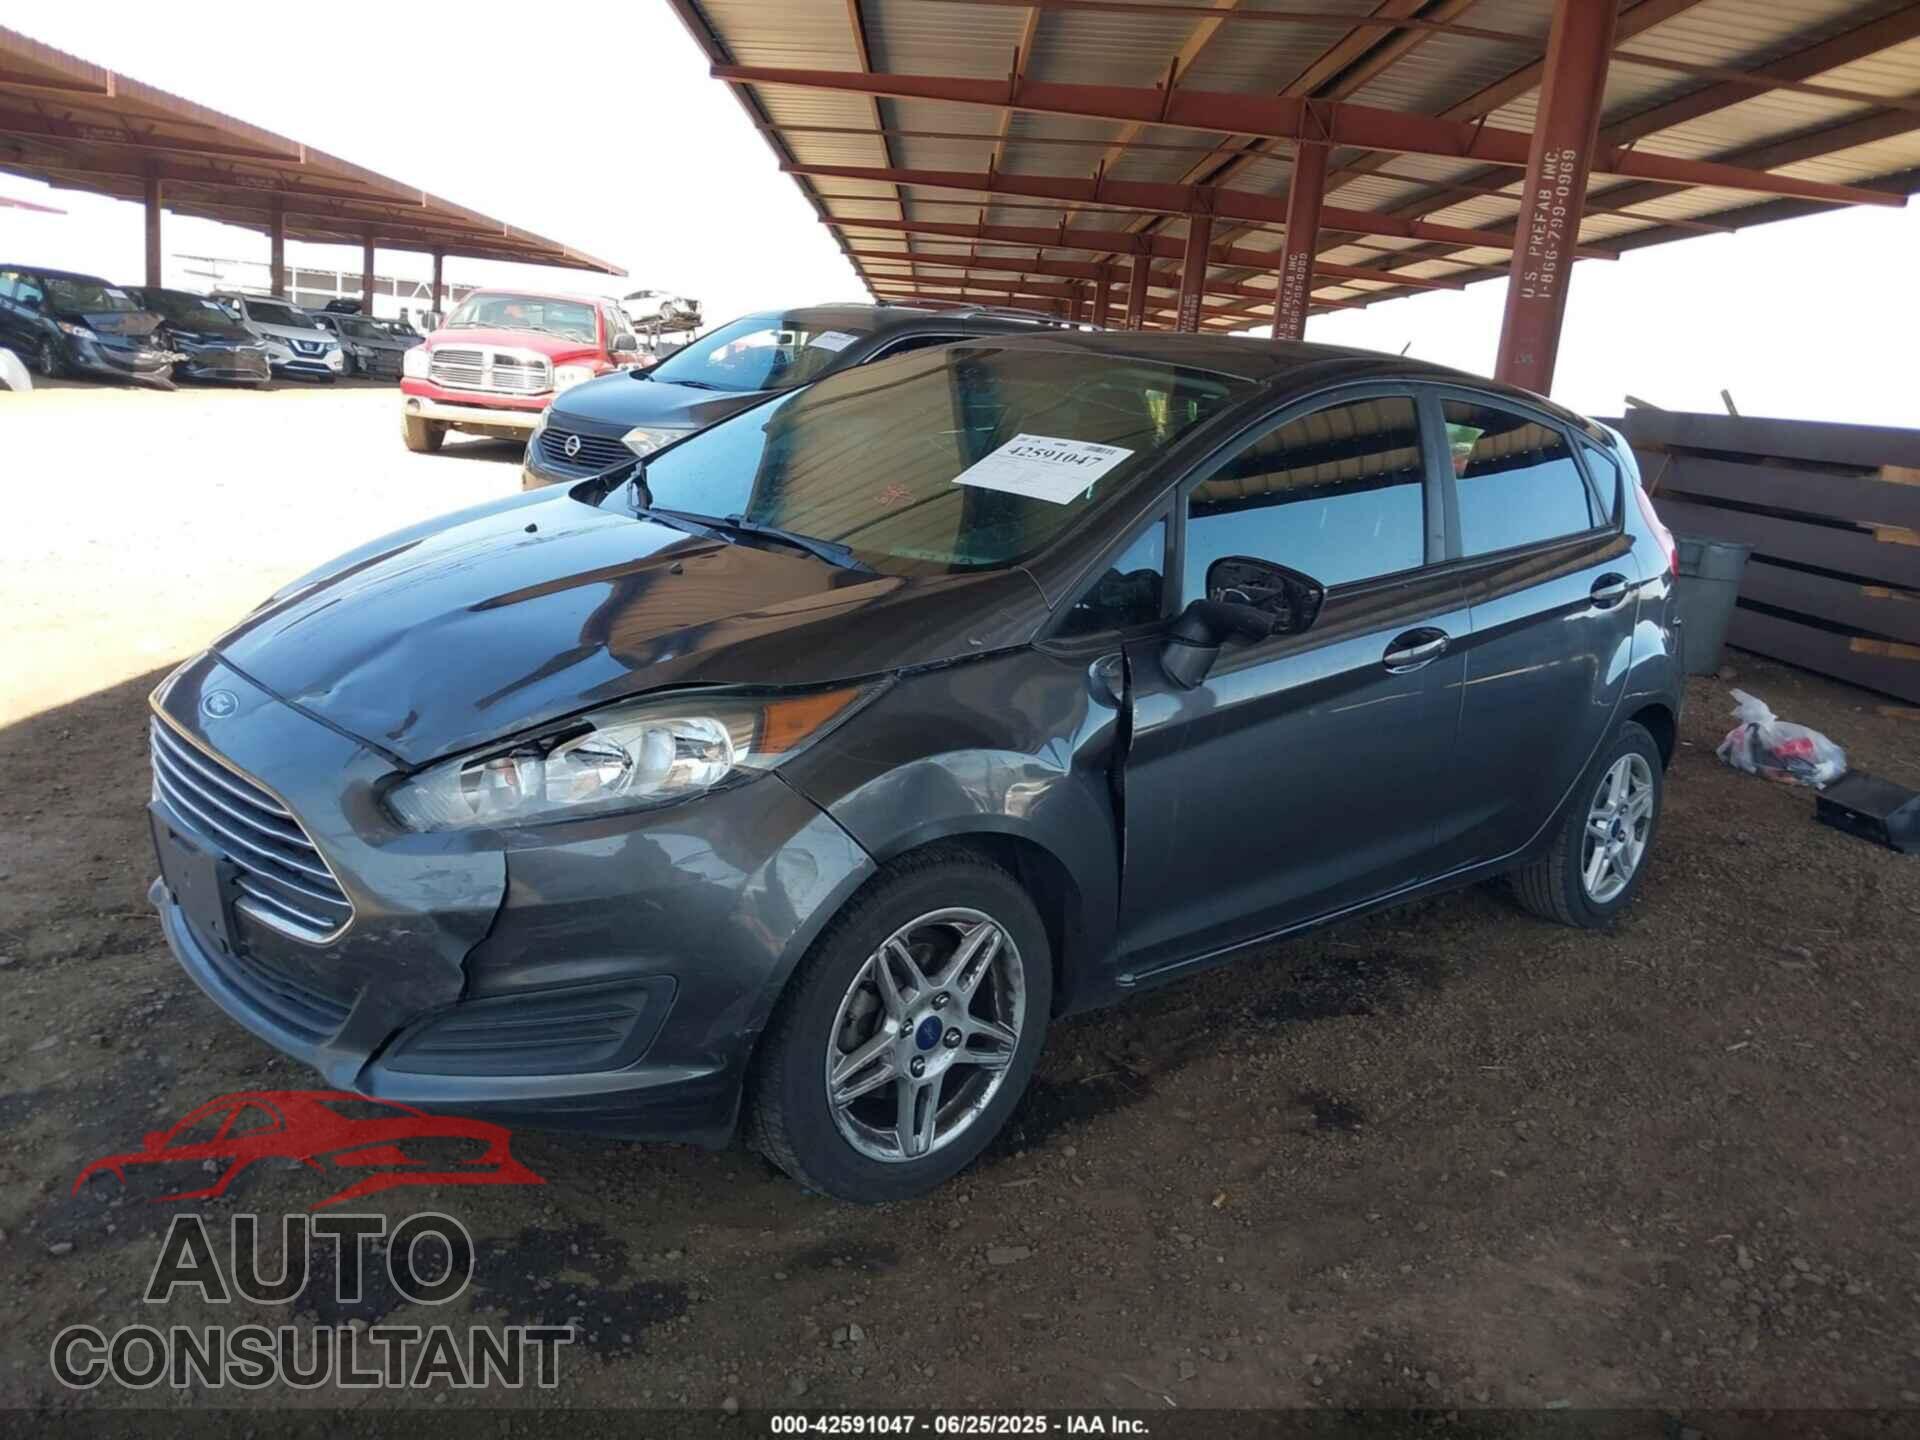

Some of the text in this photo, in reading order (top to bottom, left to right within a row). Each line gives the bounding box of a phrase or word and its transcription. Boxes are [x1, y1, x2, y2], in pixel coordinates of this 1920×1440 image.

[1528, 189, 1552, 256] PREFAB
[1538, 149, 1576, 298] 1-866-799-0969
[1282, 275, 1295, 314] PREFAB
[1008, 447, 1104, 467] 42591047
